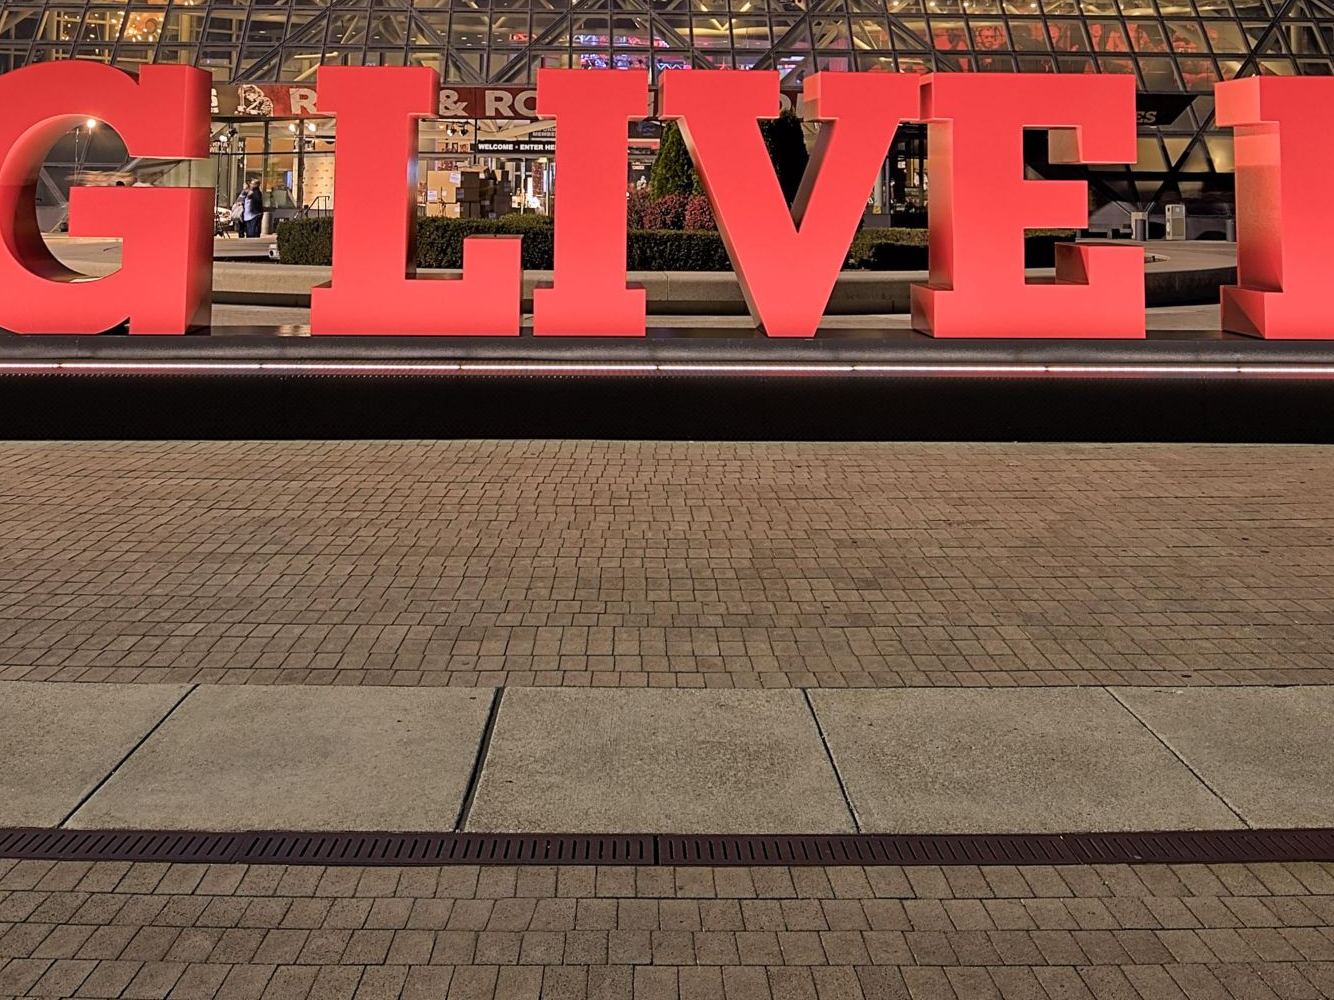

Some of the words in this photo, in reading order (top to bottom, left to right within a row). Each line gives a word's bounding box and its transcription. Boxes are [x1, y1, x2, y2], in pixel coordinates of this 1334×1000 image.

[438, 89, 468, 117] &
[485, 89, 538, 117] RO
[310, 66, 1147, 339] LIVE
